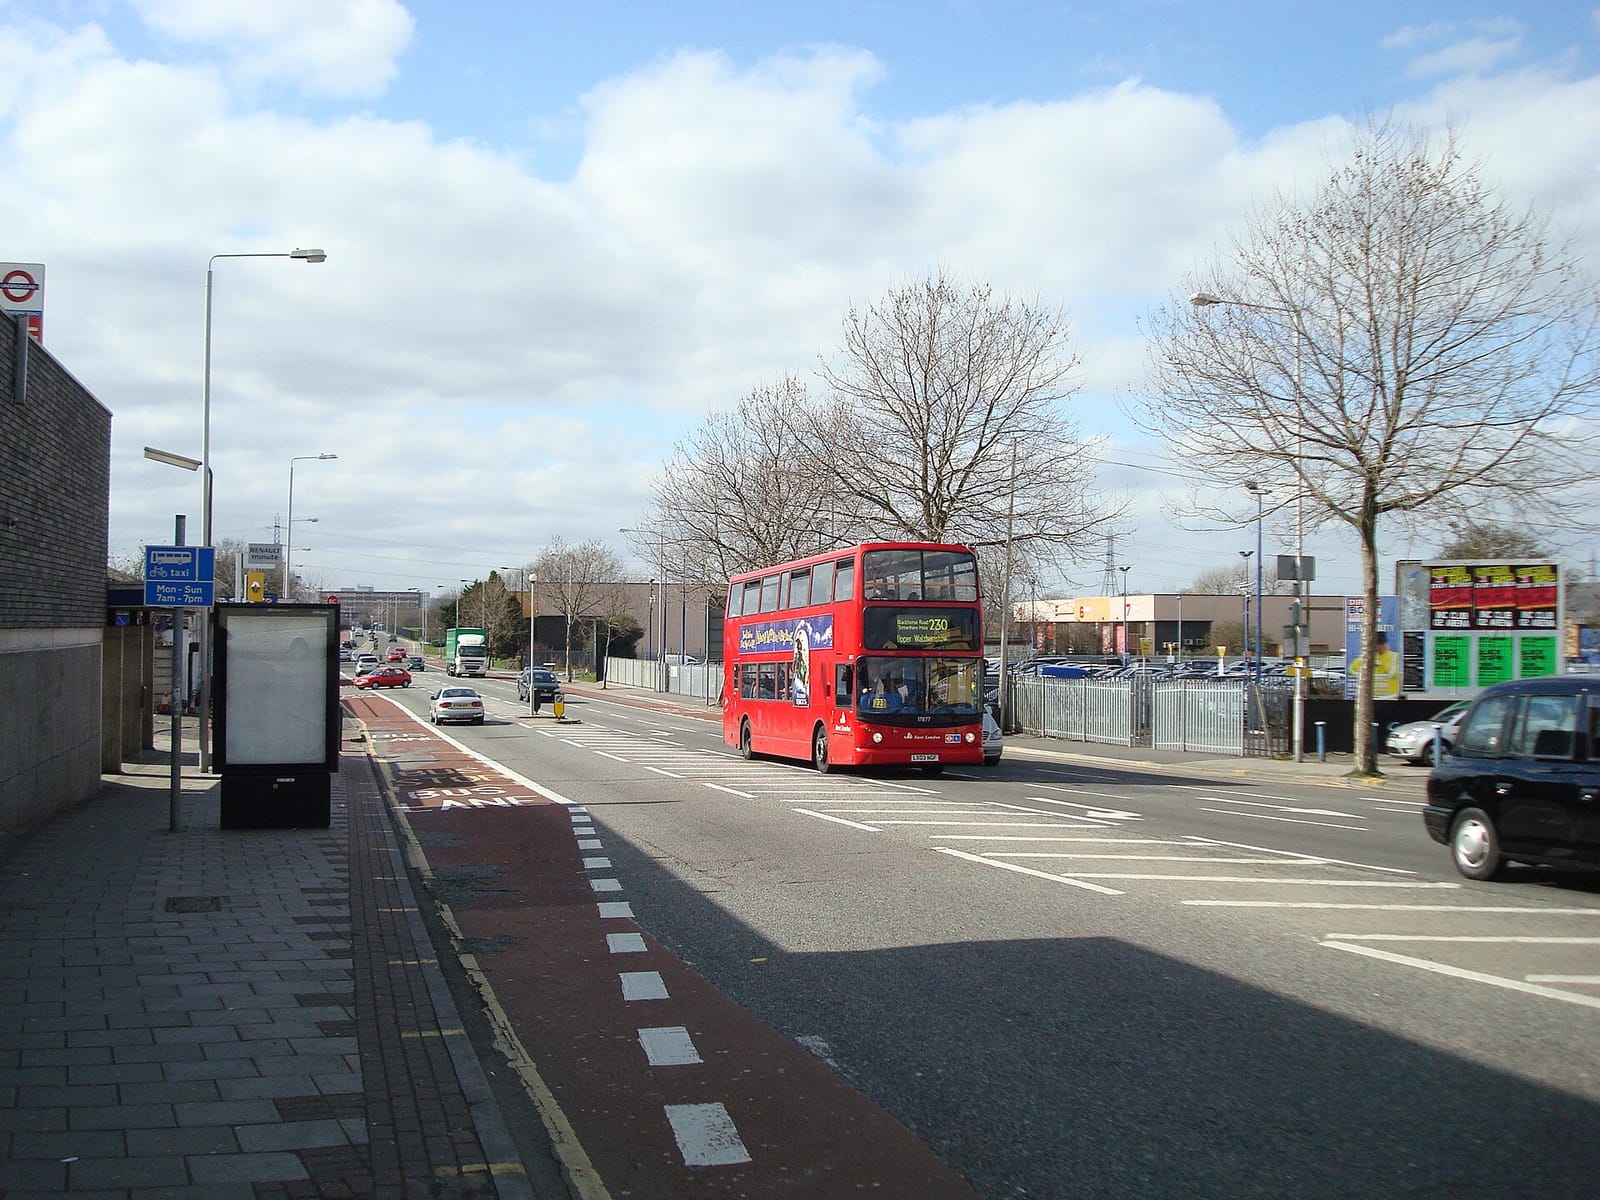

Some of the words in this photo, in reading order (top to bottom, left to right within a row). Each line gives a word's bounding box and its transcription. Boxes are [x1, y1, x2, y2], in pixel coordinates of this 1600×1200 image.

[170, 569, 189, 577] taxi
[156, 585, 177, 593] Mon
[184, 586, 202, 594] Sun
[156, 594, 176, 602] 7am
[183, 595, 203, 604] 7pm
[929, 619, 948, 631] 230
[897, 635, 912, 644] Upper
[408, 786, 507, 799] BUS
[392, 796, 538, 812] LANE
